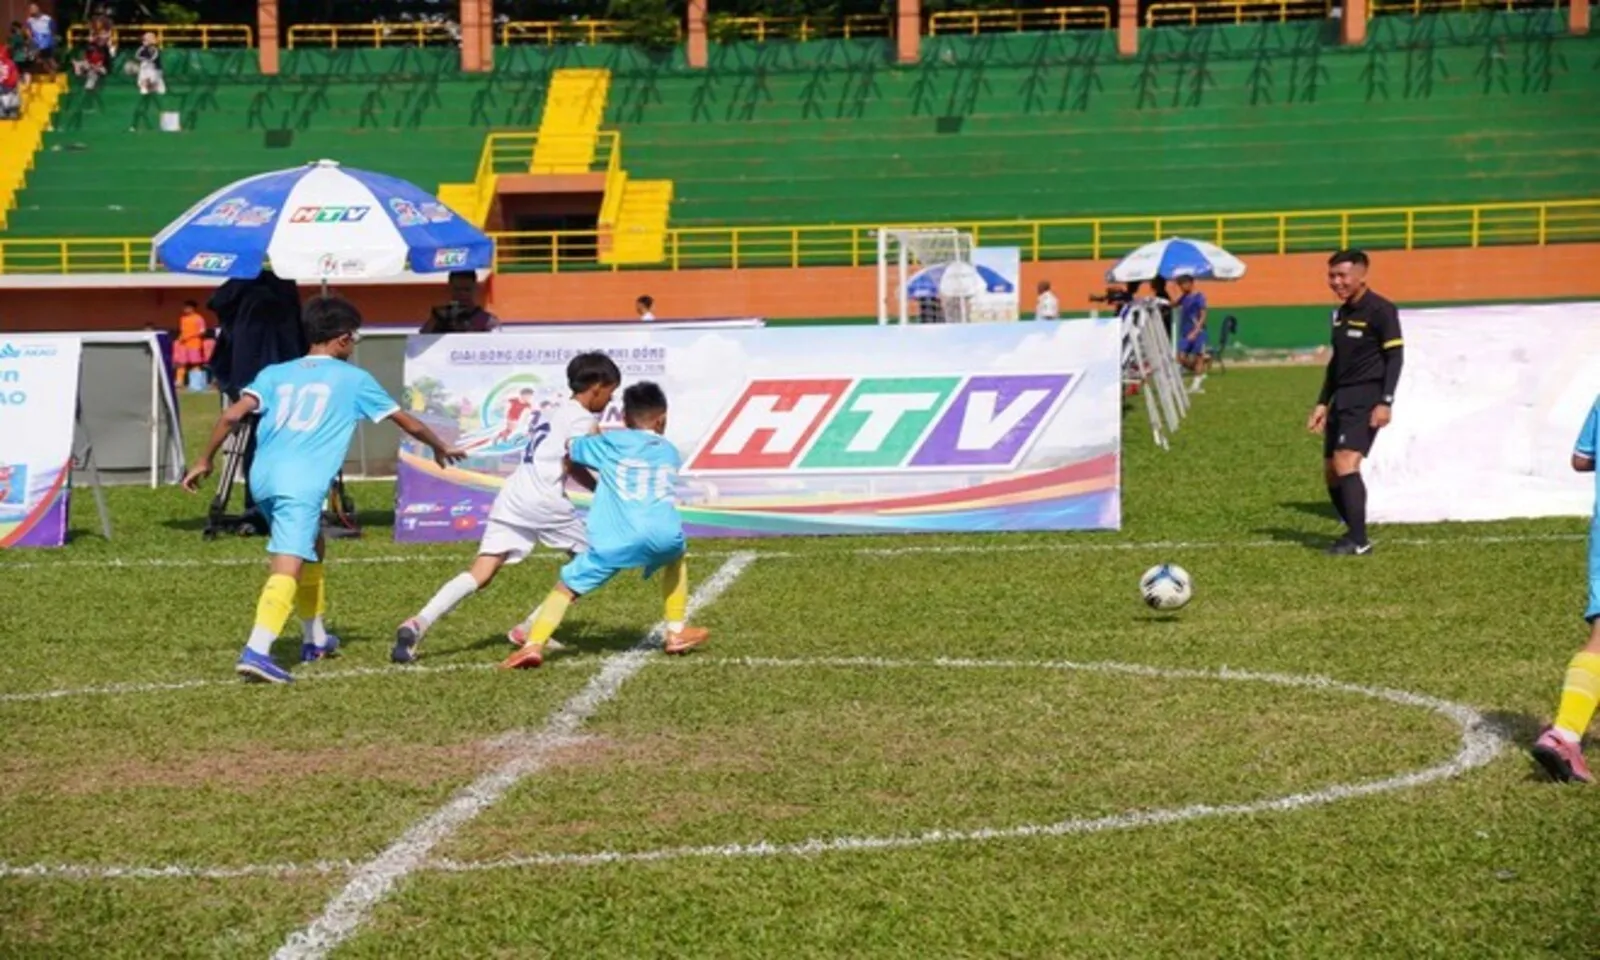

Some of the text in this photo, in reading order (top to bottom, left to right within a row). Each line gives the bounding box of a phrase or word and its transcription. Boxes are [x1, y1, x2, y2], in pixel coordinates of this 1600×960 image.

[290, 206, 370, 222] HTV
[189, 253, 237, 271] HTV
[276, 383, 331, 432] 10
[705, 385, 1057, 459] HTV
